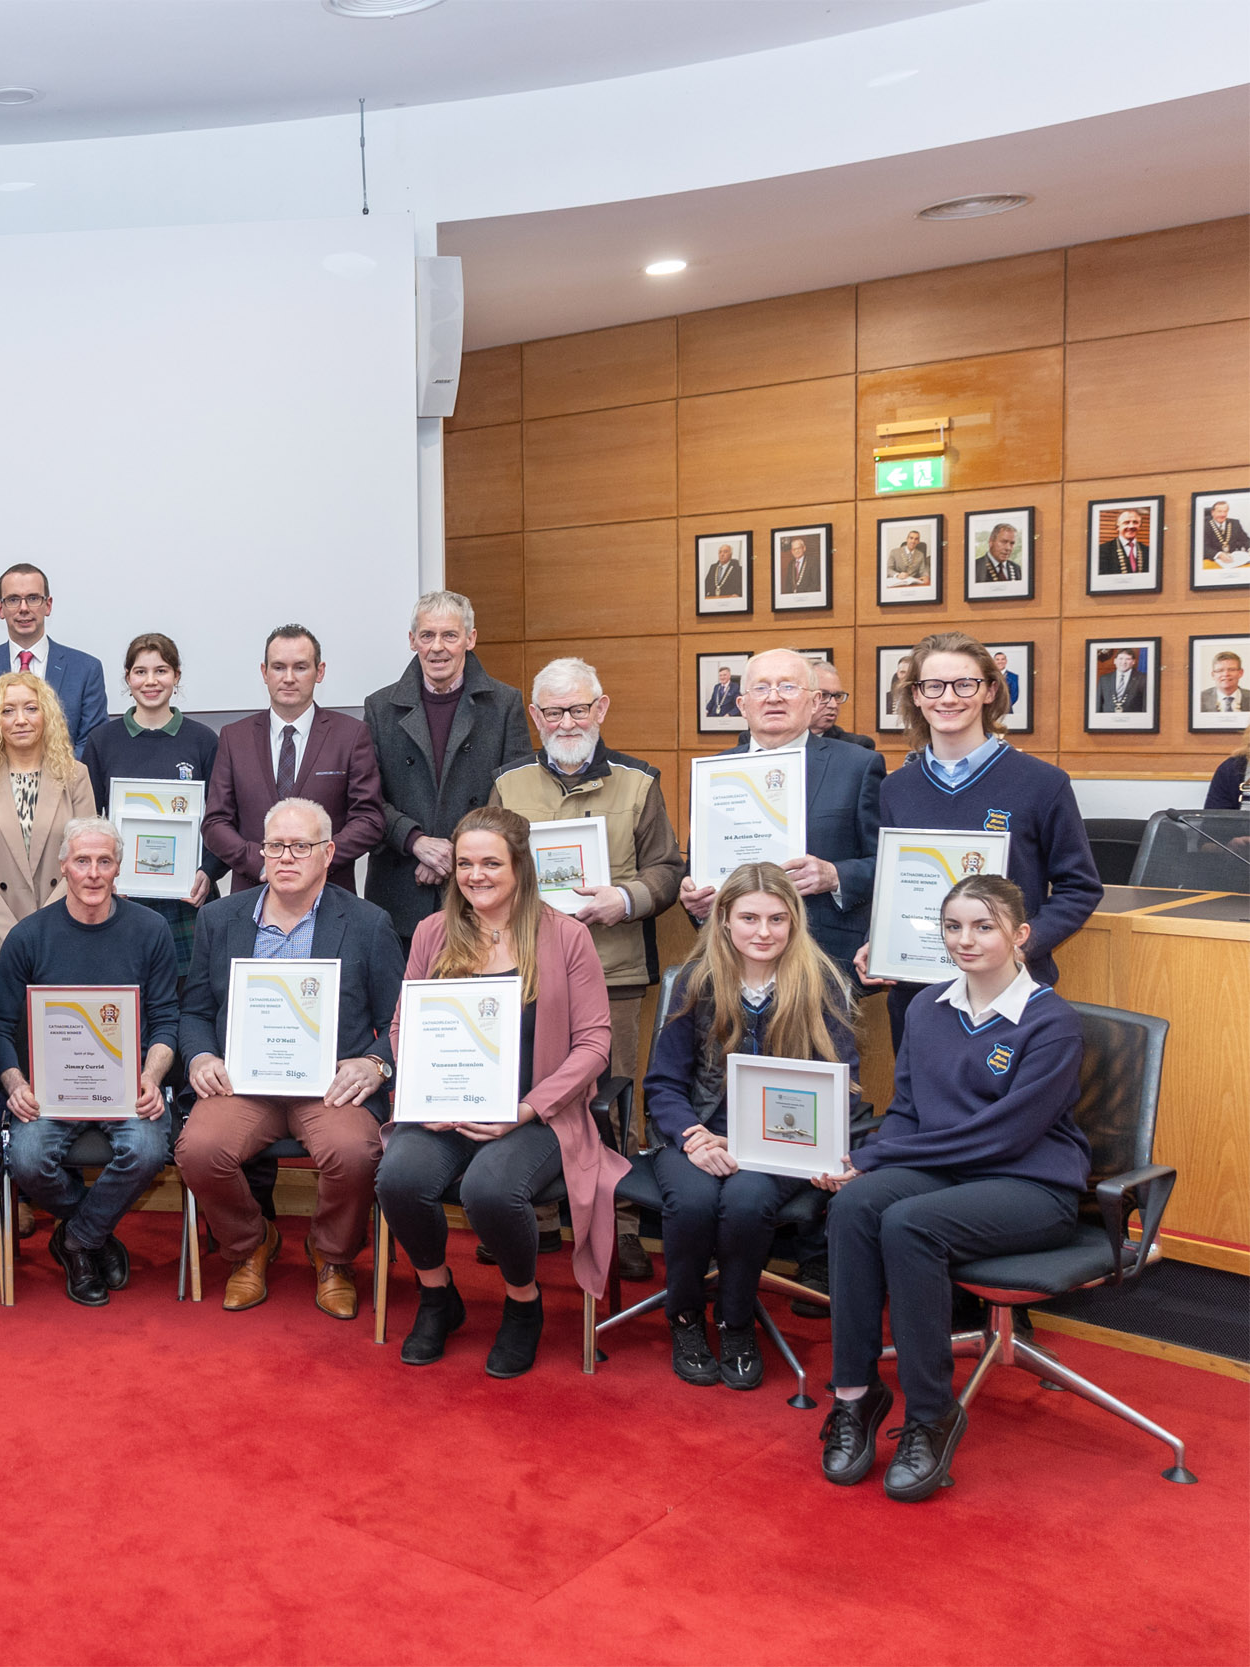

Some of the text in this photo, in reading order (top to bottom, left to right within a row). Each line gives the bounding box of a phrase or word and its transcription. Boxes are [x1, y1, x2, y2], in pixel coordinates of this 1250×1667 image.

[286, 1070, 307, 1079] Sligo.
[92, 1094, 114, 1102] Sligo.
[463, 1095, 486, 1103] Sligo.
